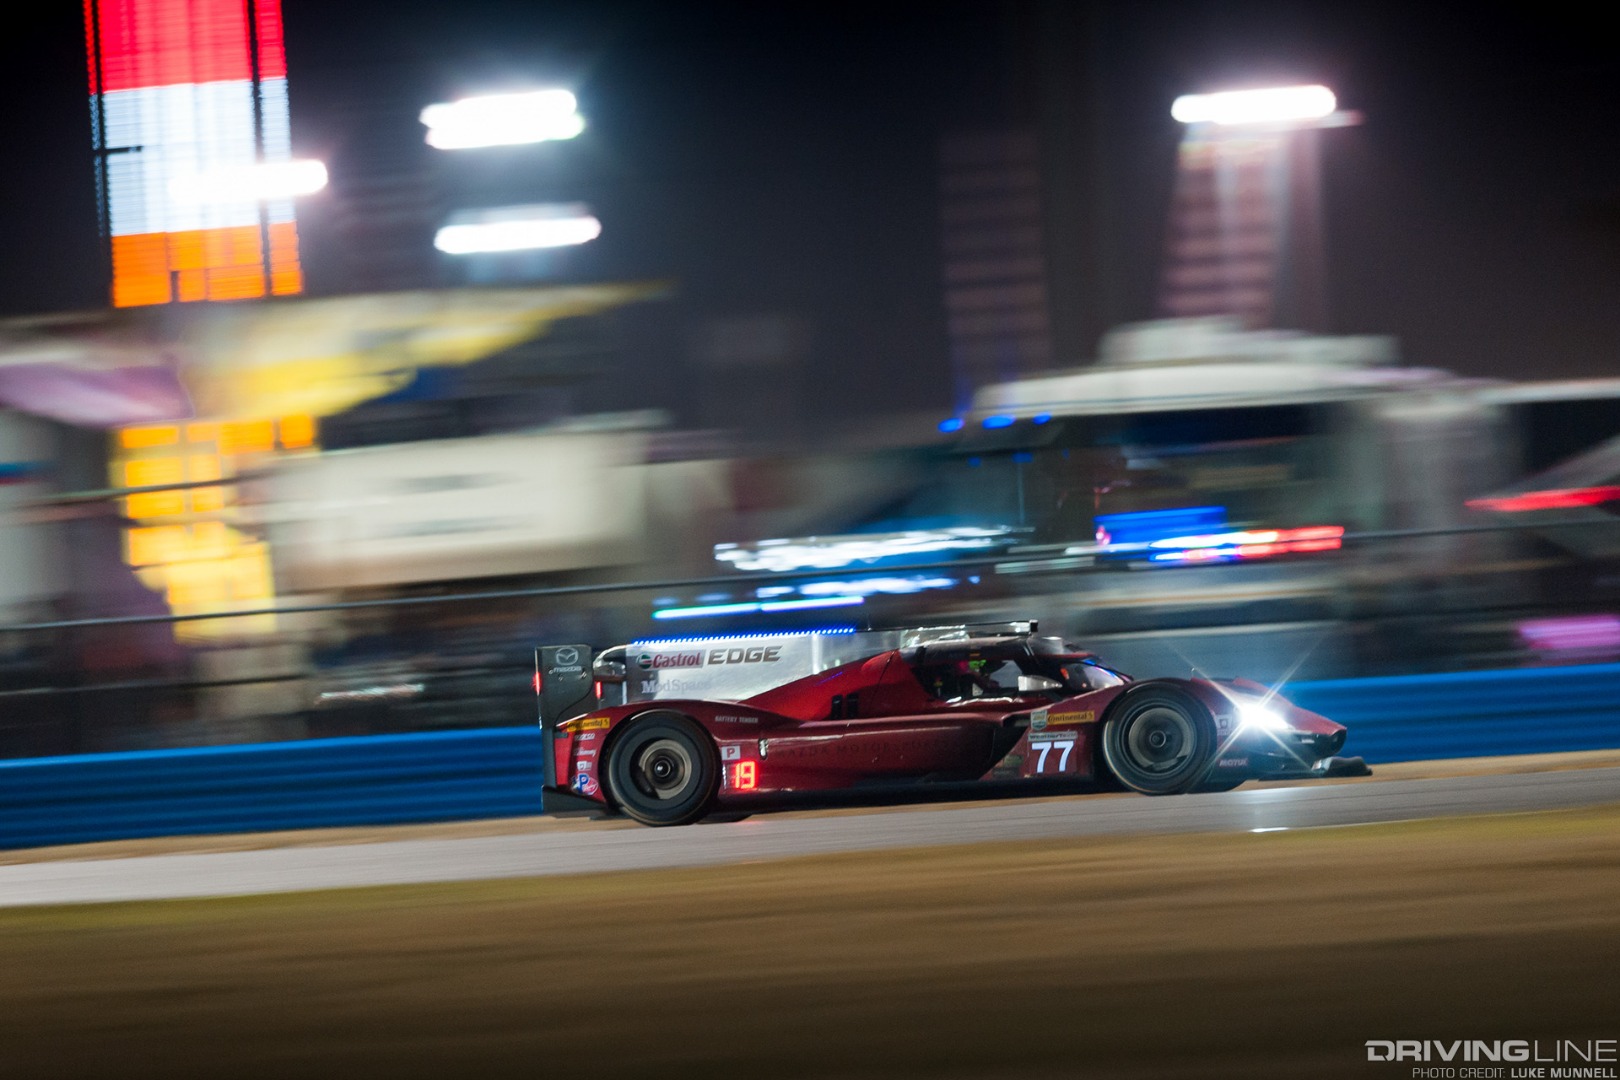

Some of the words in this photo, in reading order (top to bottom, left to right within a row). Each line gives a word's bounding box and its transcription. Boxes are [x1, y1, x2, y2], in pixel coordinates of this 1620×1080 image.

[652, 652, 701, 669] Castrol
[707, 645, 784, 665] EDGE
[726, 747, 736, 760] P
[1031, 740, 1075, 774] 77
[735, 761, 756, 789] 19
